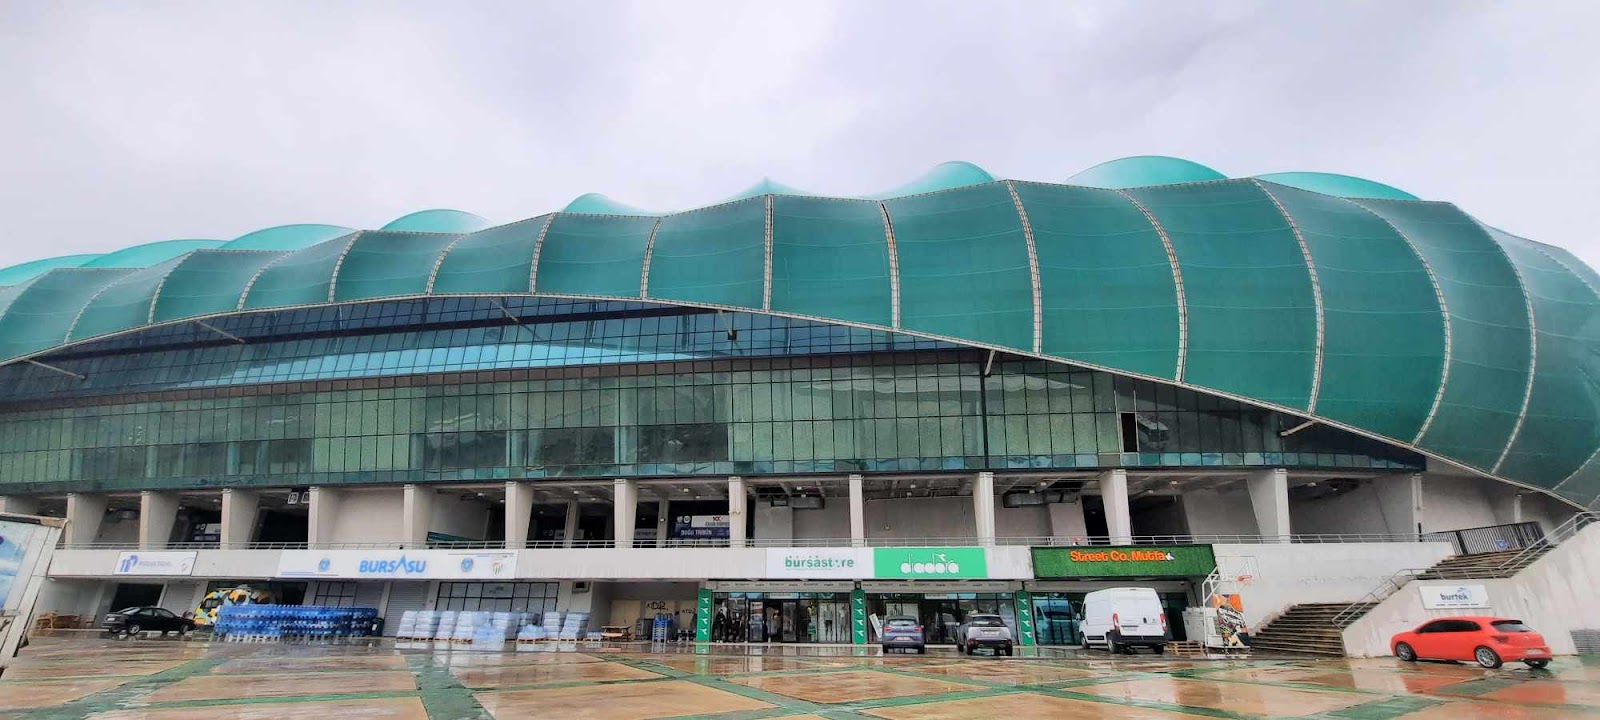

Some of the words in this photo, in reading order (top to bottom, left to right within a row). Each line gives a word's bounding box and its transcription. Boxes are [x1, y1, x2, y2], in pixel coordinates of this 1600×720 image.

[900, 552, 960, 573] diadora
[1070, 550, 1108, 562] Street
[1110, 550, 1130, 561] Co.
[359, 555, 426, 574] BURSASU
[1440, 593, 1468, 601] burtek
